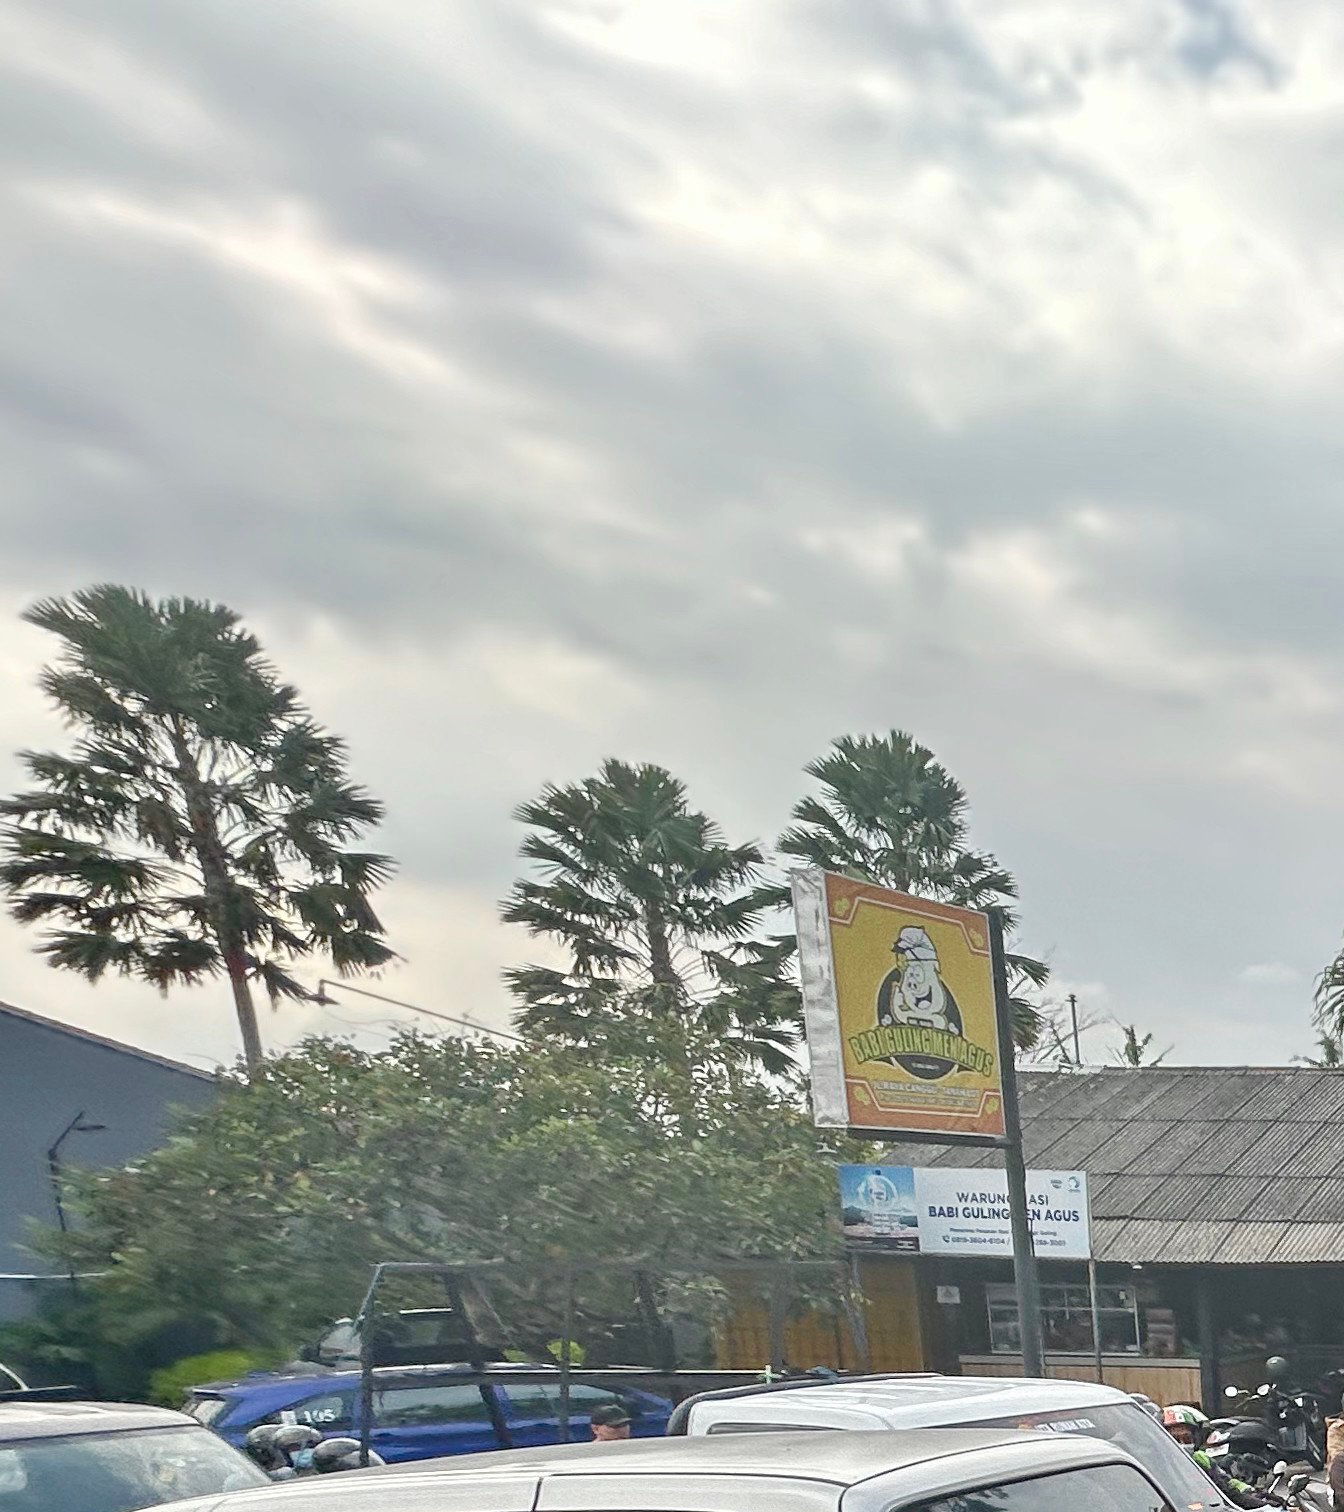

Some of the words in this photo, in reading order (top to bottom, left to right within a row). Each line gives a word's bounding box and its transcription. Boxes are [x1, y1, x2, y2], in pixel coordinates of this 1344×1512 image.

[849, 1027, 885, 1064] BABI
[883, 1026, 931, 1055] GULING
[957, 1038, 994, 1077] AGUS
[1029, 1194, 1049, 1206] ASI
[928, 1206, 959, 1218] BABI
[962, 1207, 1011, 1220] GULING
[1026, 1209, 1041, 1220] EN
[1045, 1210, 1080, 1222] AGUS
